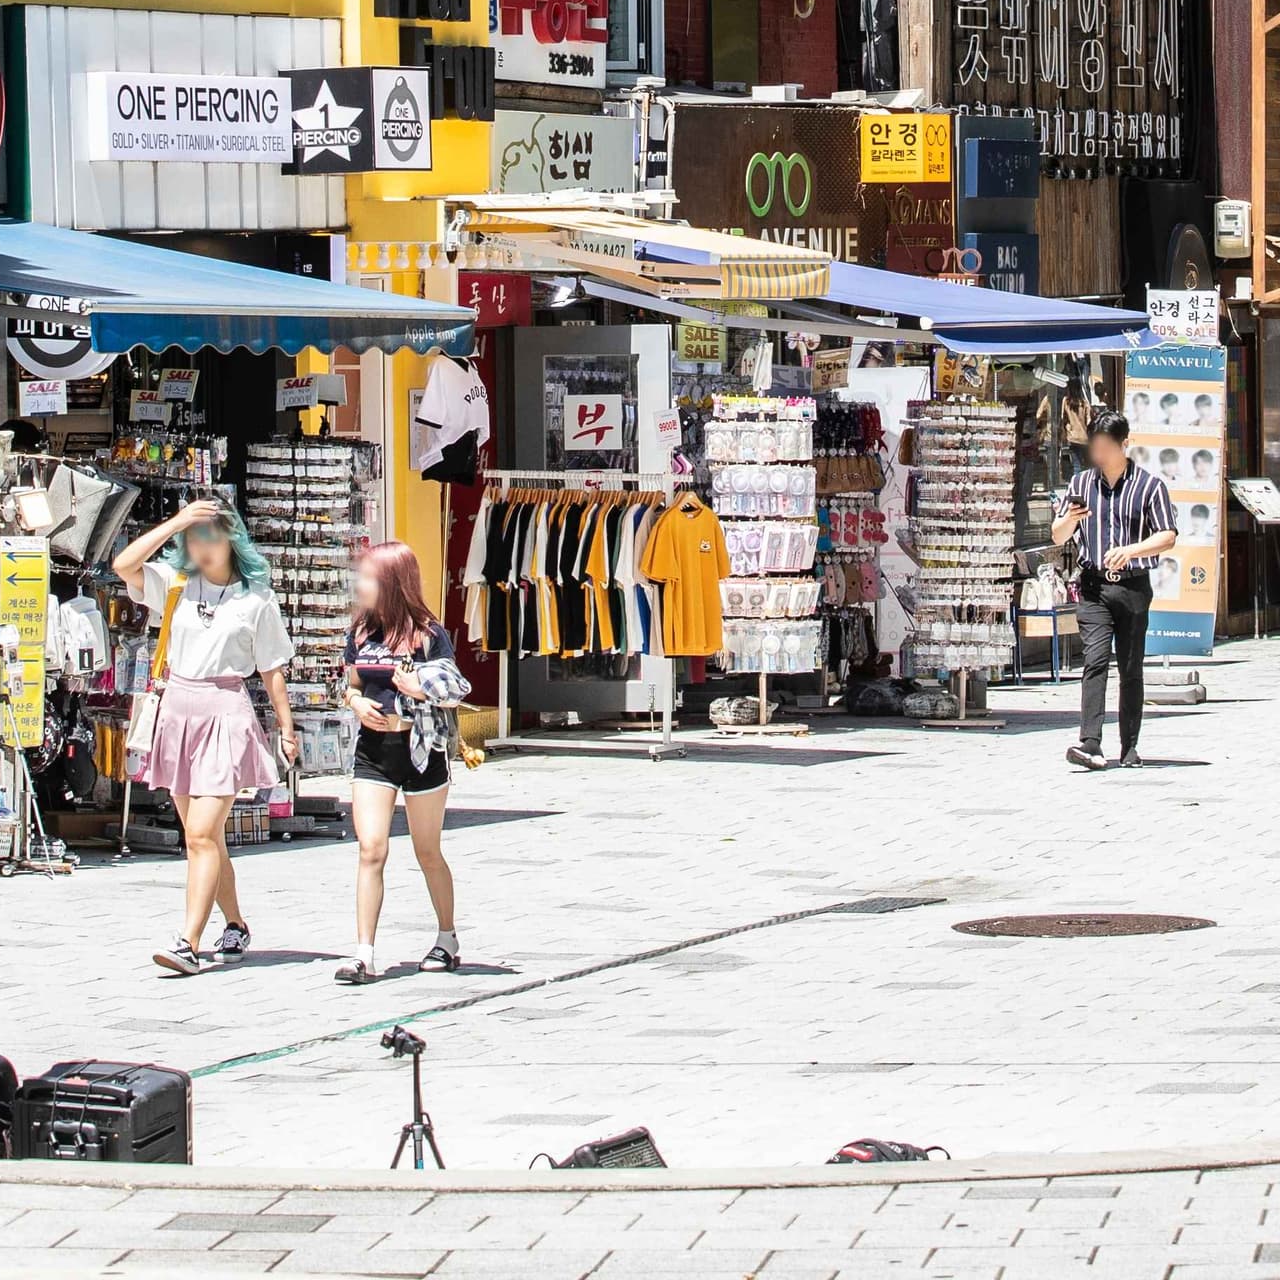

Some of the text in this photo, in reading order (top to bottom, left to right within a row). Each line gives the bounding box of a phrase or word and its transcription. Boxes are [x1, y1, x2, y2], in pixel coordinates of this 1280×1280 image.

[117, 84, 279, 123] ONE PIERCING
[395, 106, 409, 118] ONE
[382, 120, 423, 139] PIERCING
[869, 122, 918, 147] 안경
[111, 132, 286, 152] GOLD SILVER TITANIUM SURGICAL STEEL
[293, 129, 361, 147] PIERCING
[548, 129, 593, 181] 한샘
[870, 148, 917, 162] 칼라렌즈
[997, 245, 1018, 269] BAG
[39, 296, 70, 311] ONE
[1149, 298, 1181, 318] 안경
[404, 323, 457, 343] Apple Ring
[685, 325, 719, 342] SALE
[1152, 325, 1217, 338] 50% SALE
[684, 344, 720, 359] SALE
[1136, 355, 1213, 369] WANNAFUL
[166, 370, 194, 380] SALE
[26, 381, 61, 394] SALE
[283, 377, 314, 390] SALE
[138, 390, 159, 401] SAL
[572, 403, 615, 446] 부
[7, 597, 38, 609] 계산은
